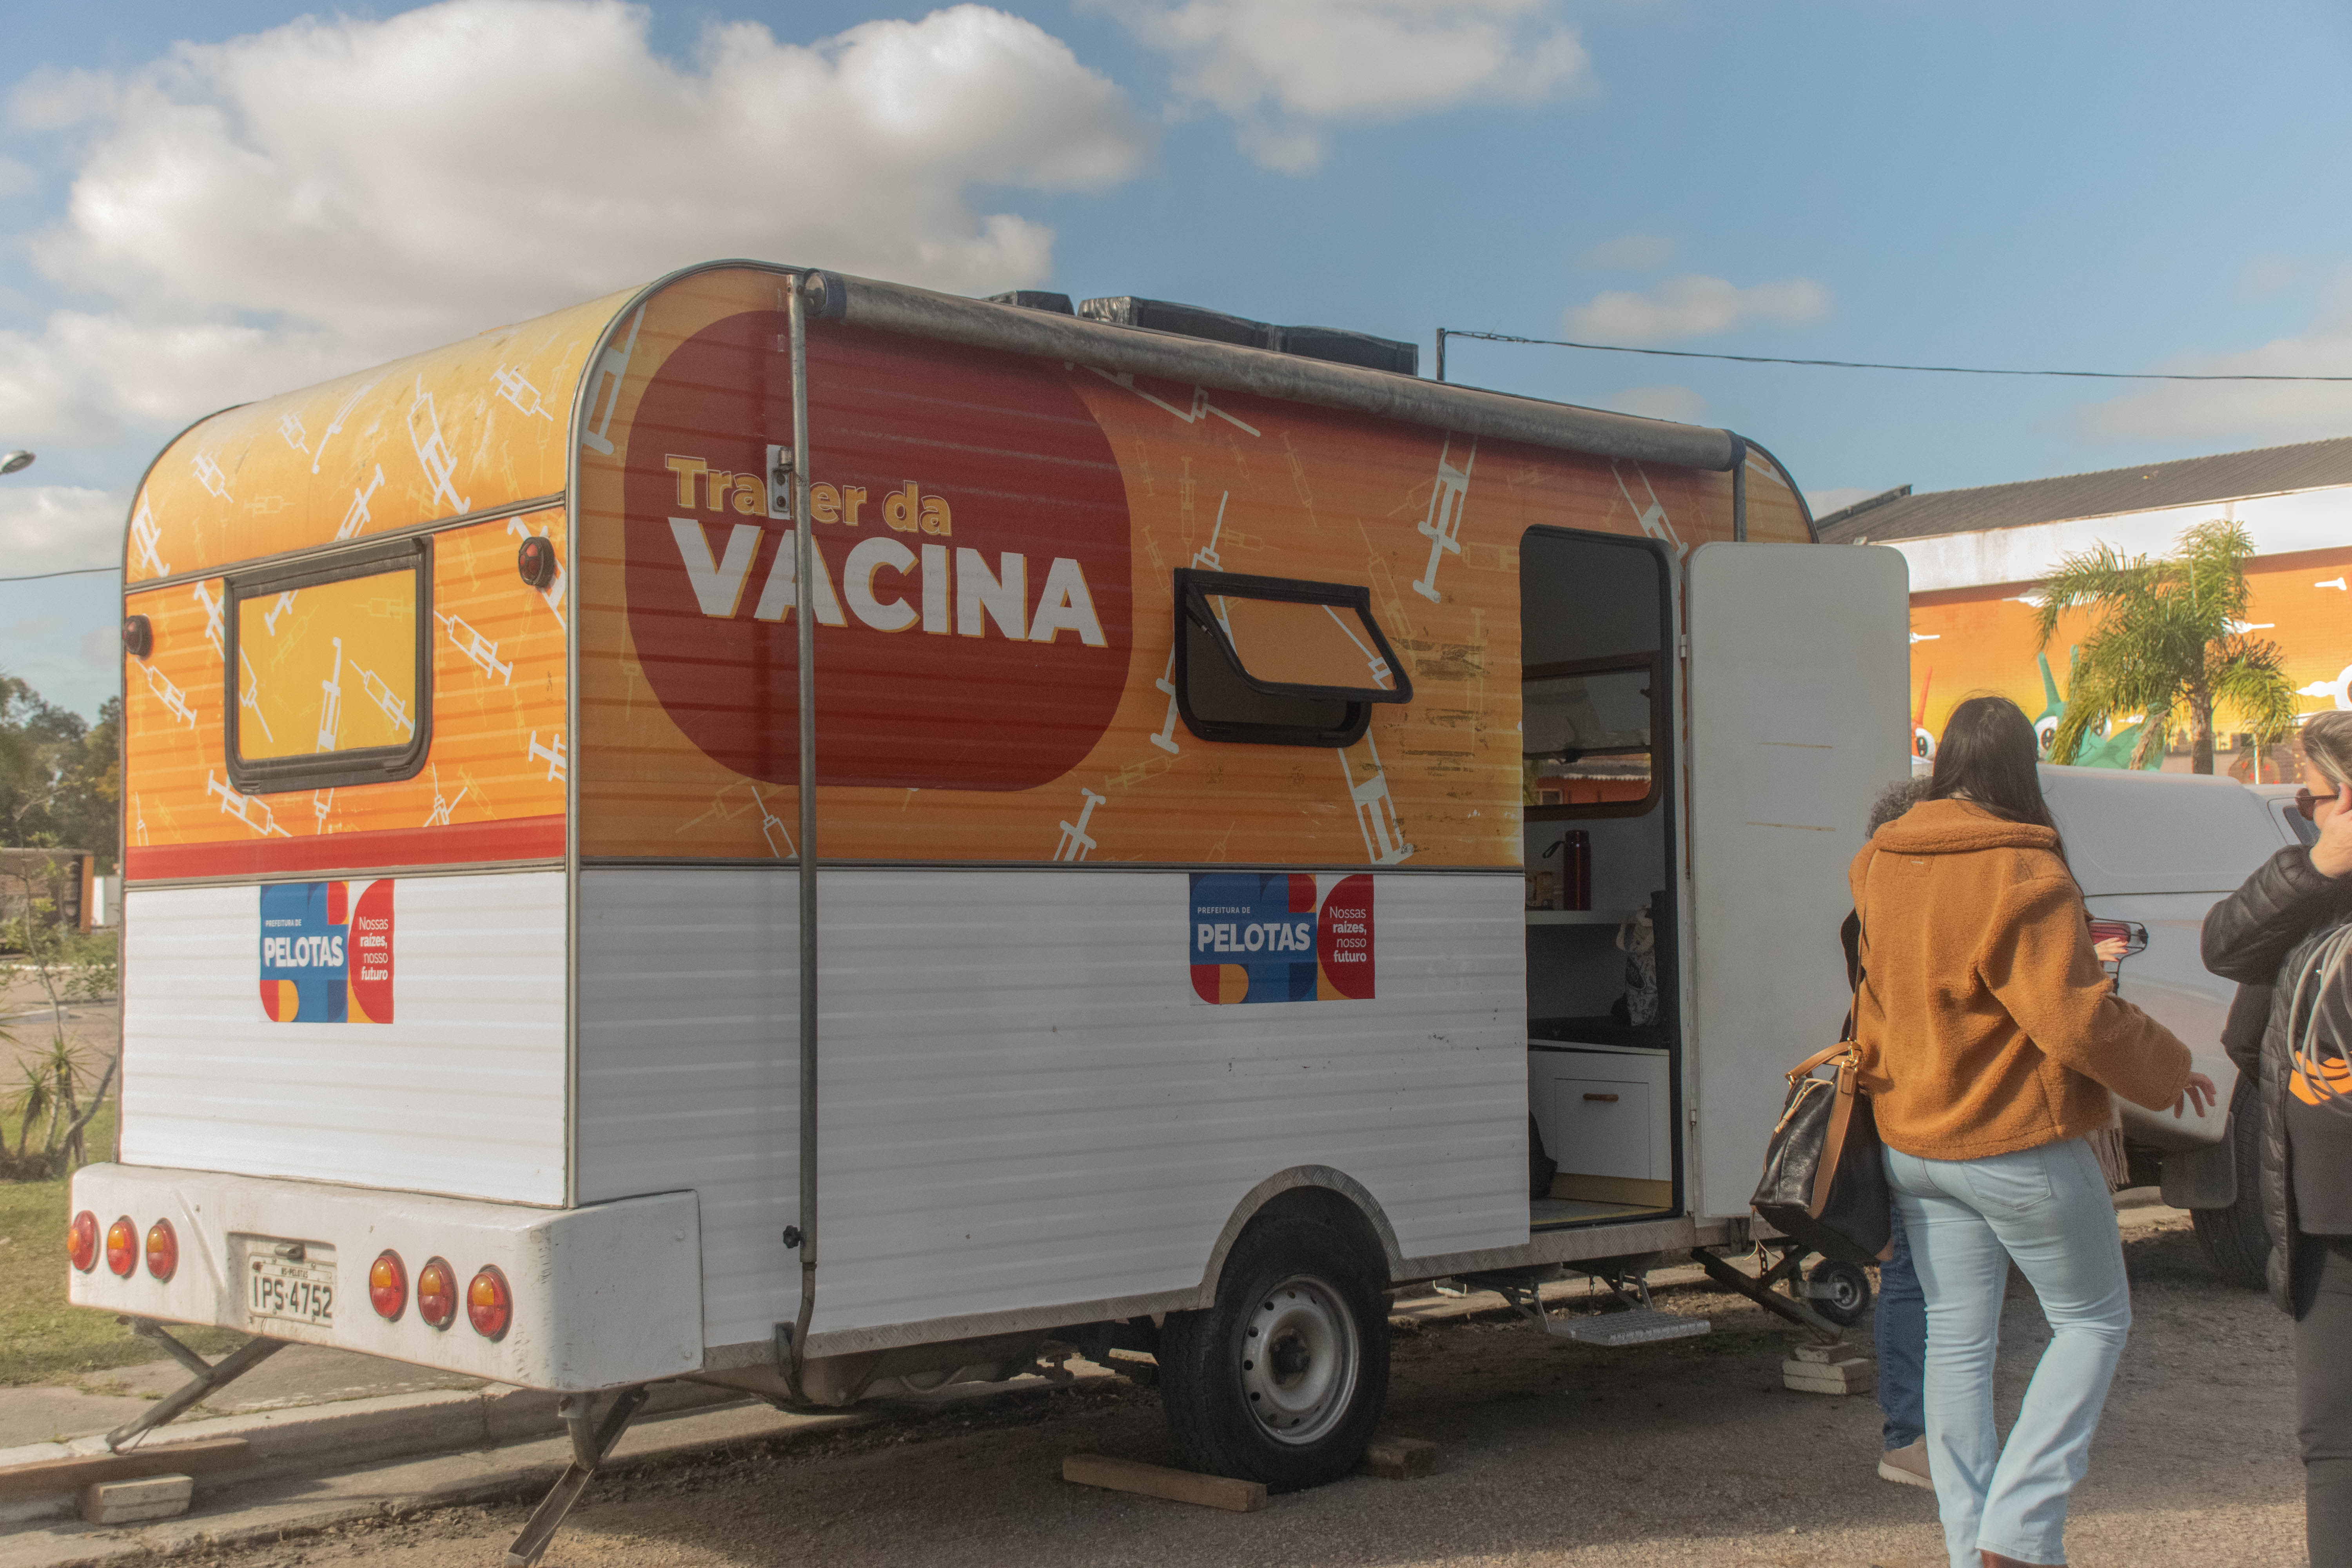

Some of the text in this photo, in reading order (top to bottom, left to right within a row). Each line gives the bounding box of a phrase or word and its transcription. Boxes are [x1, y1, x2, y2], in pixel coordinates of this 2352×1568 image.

[665, 454, 952, 536] Traer da
[668, 516, 1109, 648] VACINA
[1330, 906, 1366, 919] Nossas
[265, 919, 294, 927] PREFEITURA
[359, 916, 388, 930] Nossas
[1333, 921, 1367, 935] raízes,
[360, 933, 388, 949] raízes,
[1198, 922, 1311, 952] PELOTAS
[1336, 938, 1367, 948] nosso
[264, 935, 344, 967] PELOTAS
[363, 952, 388, 964] nosso
[1334, 950, 1367, 963] futuro
[361, 966, 388, 980] futuro
